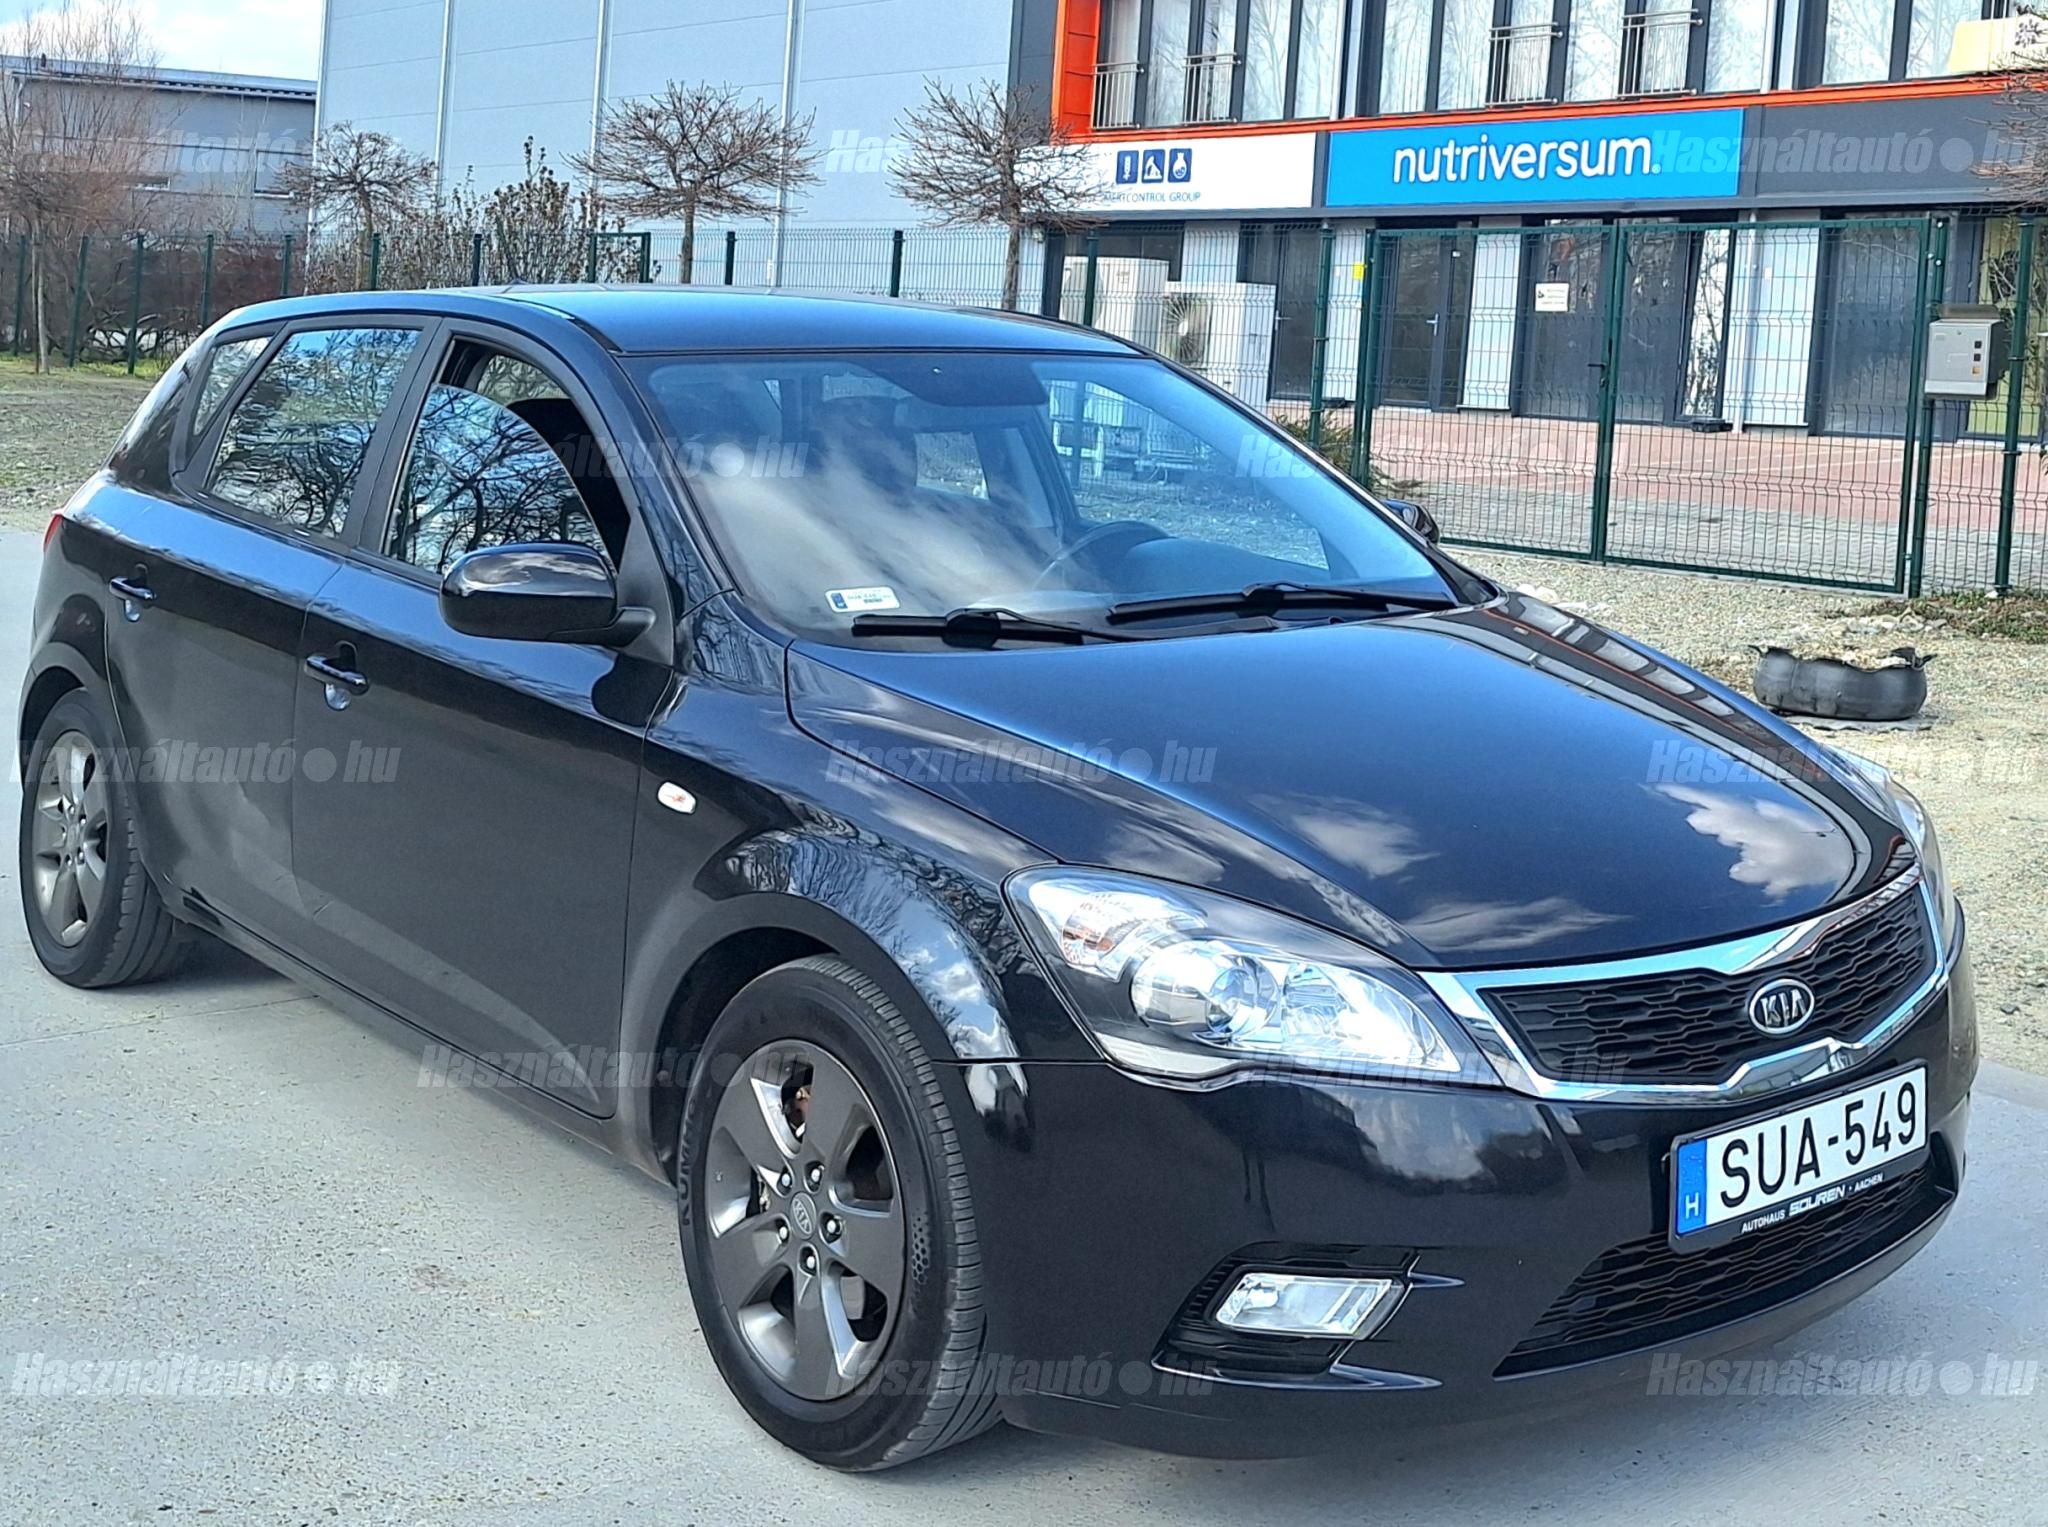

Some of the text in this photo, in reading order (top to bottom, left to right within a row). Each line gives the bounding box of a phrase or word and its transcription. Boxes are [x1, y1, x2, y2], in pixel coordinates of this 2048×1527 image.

[1169, 191, 1201, 202] GROUP
[1760, 988, 1807, 1028] KIA
[1719, 1081, 1917, 1208] SUA-549
[793, 1198, 812, 1234] KIA
[1684, 1191, 1700, 1219] H
[1741, 1172, 1884, 1234] AUTOHAUS SOUREN AACHEN
